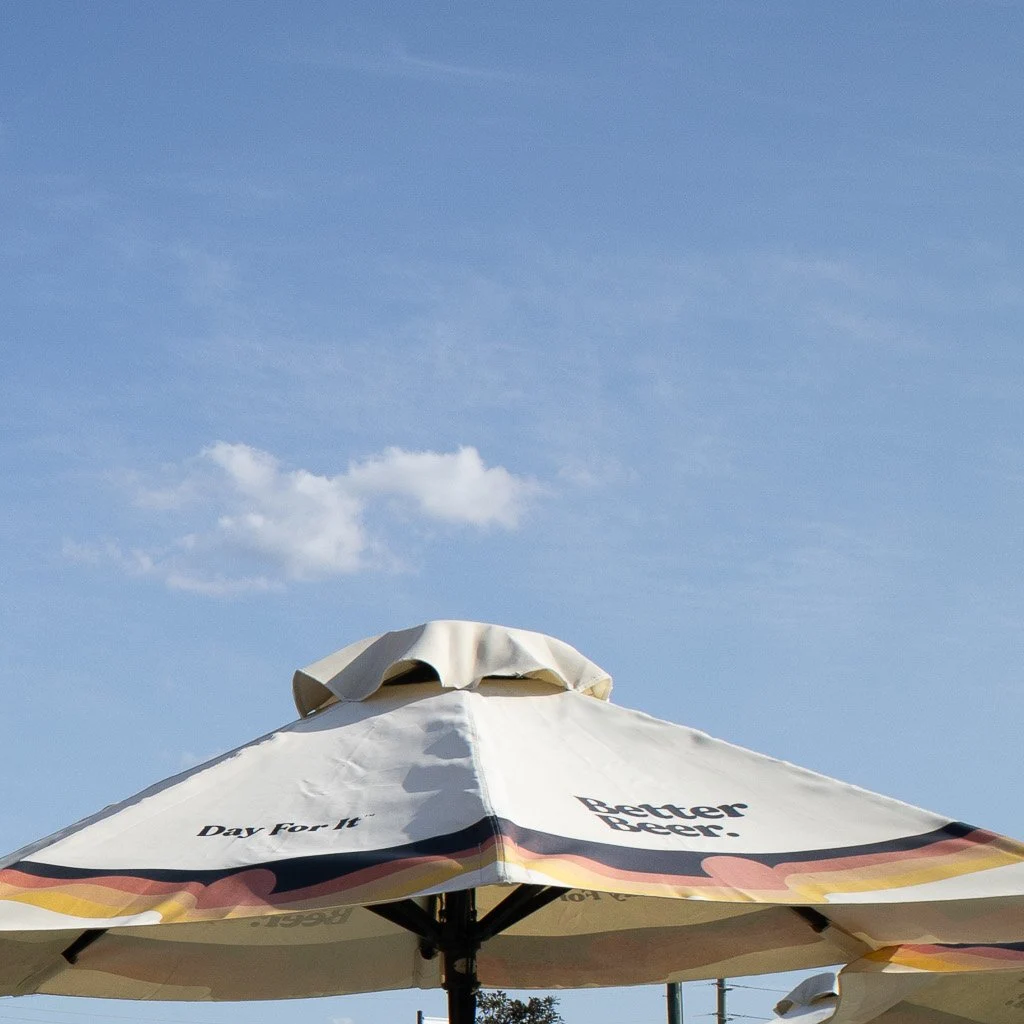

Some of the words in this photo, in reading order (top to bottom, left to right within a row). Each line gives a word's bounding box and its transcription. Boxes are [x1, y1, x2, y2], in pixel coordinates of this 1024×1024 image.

[573, 795, 749, 820] Better
[195, 824, 265, 839] Day
[269, 822, 329, 836] For
[332, 816, 363, 831] It
[594, 813, 741, 838] Beer.
